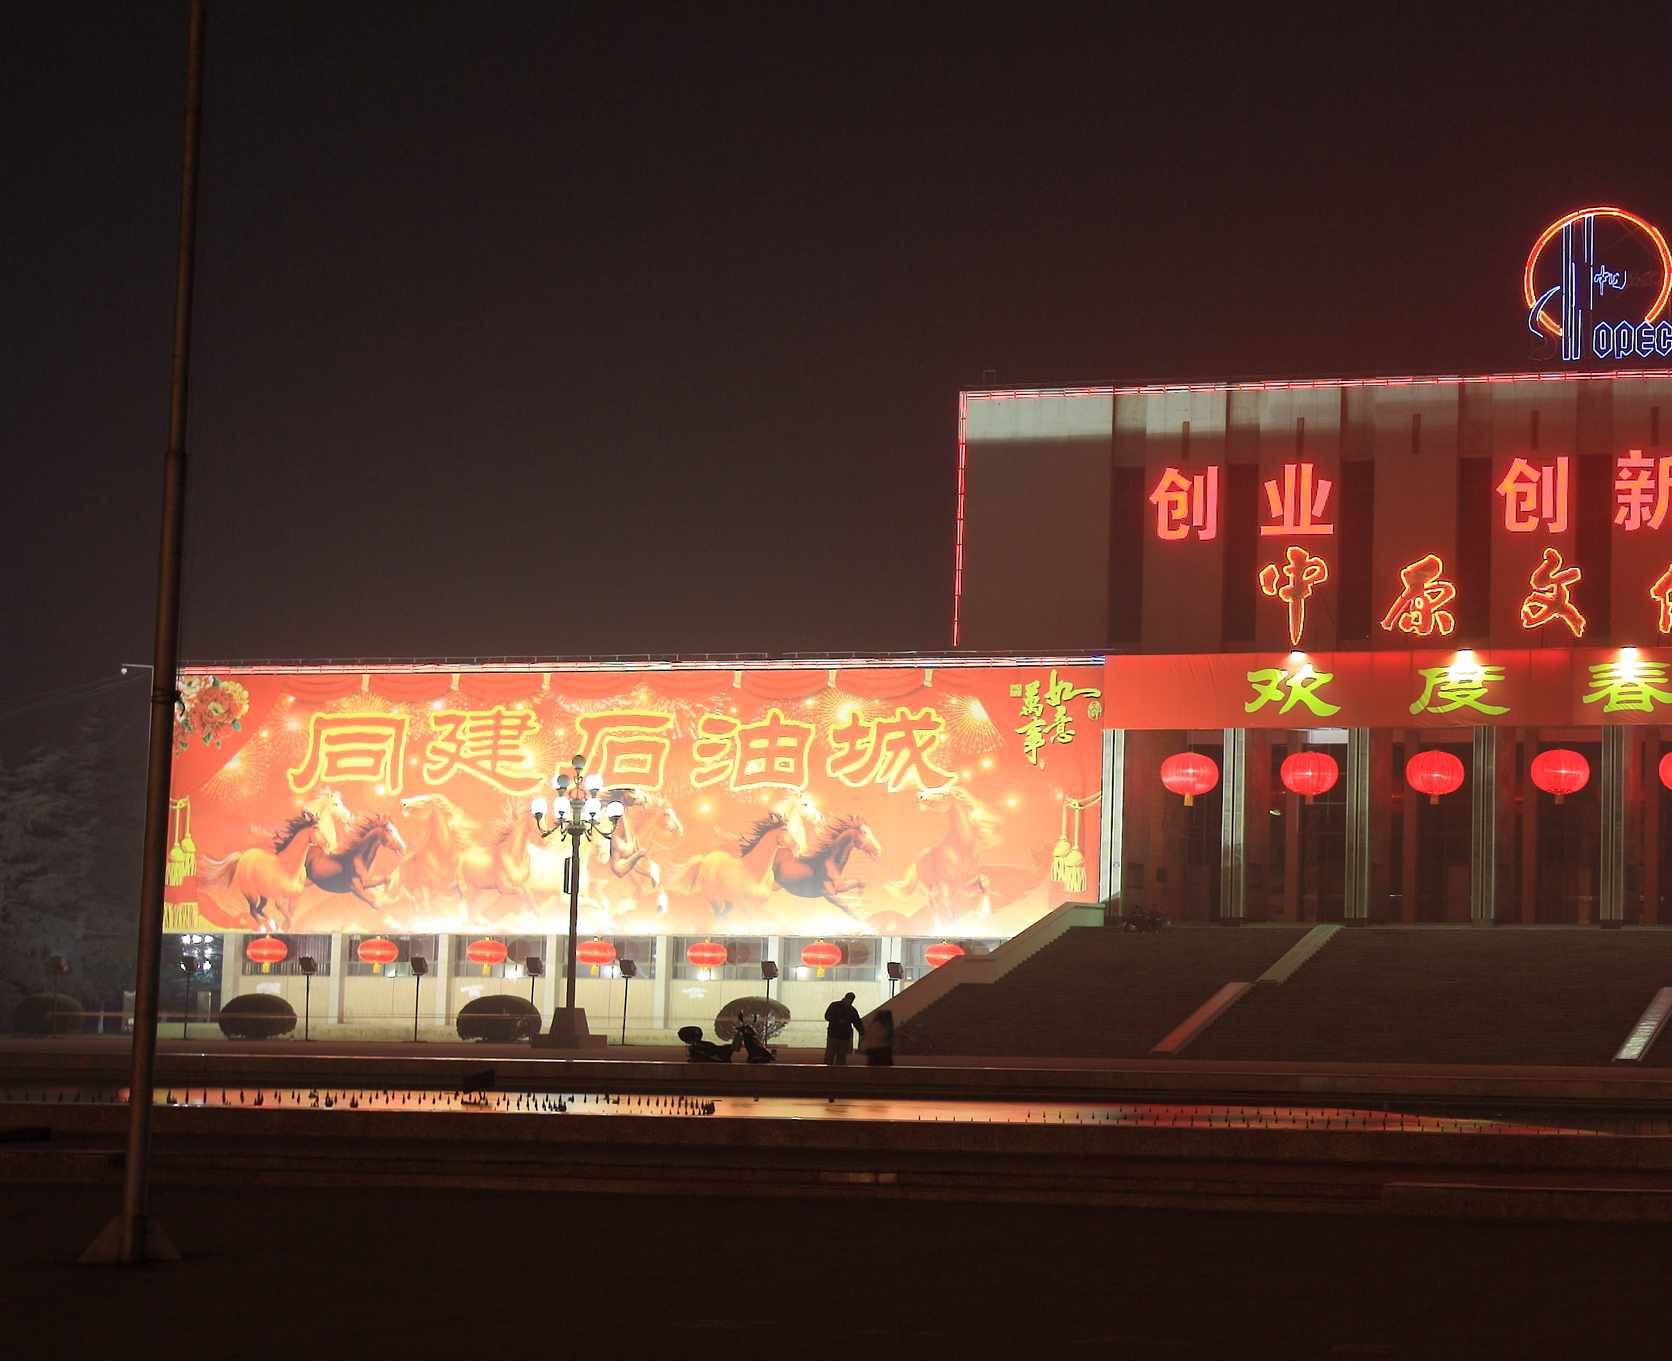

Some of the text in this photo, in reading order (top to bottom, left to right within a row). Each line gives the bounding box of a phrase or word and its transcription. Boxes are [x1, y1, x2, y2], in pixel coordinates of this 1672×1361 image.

[1149, 463, 1333, 541] 创业
[288, 706, 959, 793] 同建石油城
